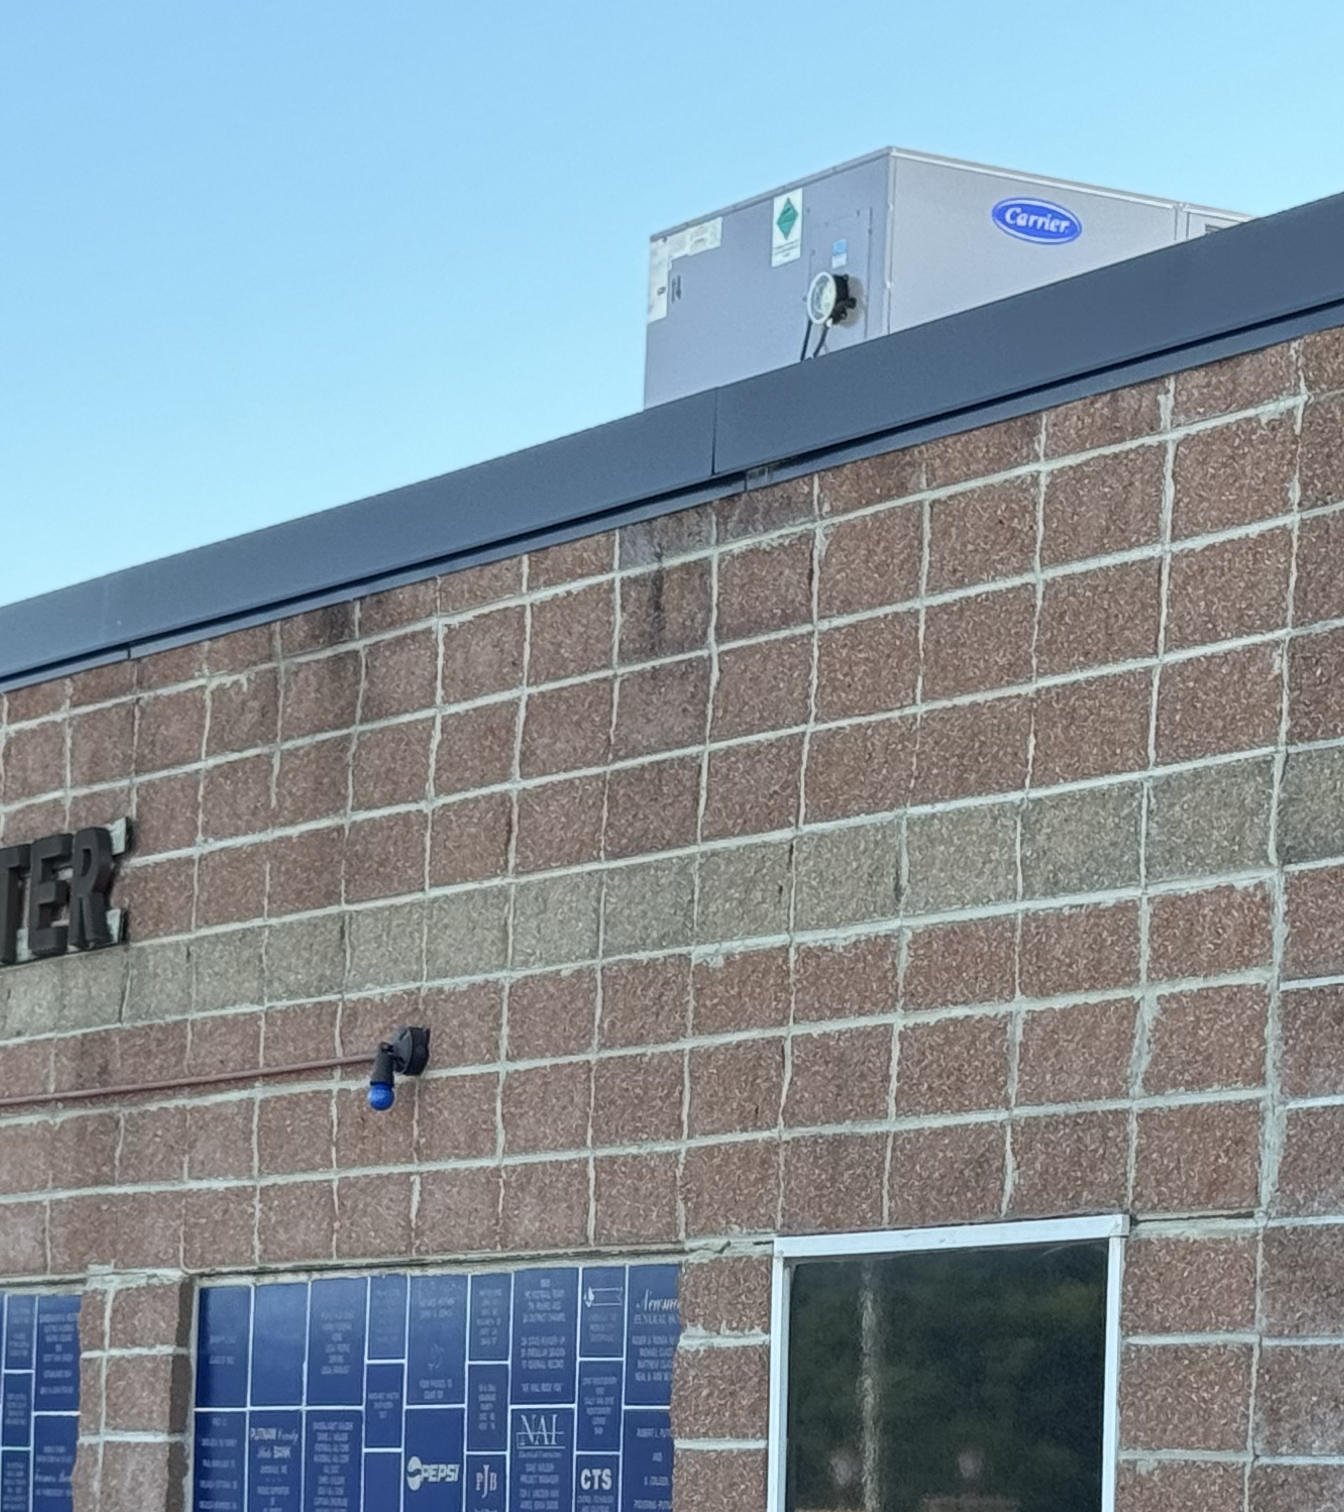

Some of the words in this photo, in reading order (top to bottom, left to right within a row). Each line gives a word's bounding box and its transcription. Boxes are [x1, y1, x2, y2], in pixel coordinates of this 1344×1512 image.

[1005, 207, 1071, 233] Carrier
[420, 1463, 460, 1482] PEPSI
[580, 1468, 612, 1490] CTS
